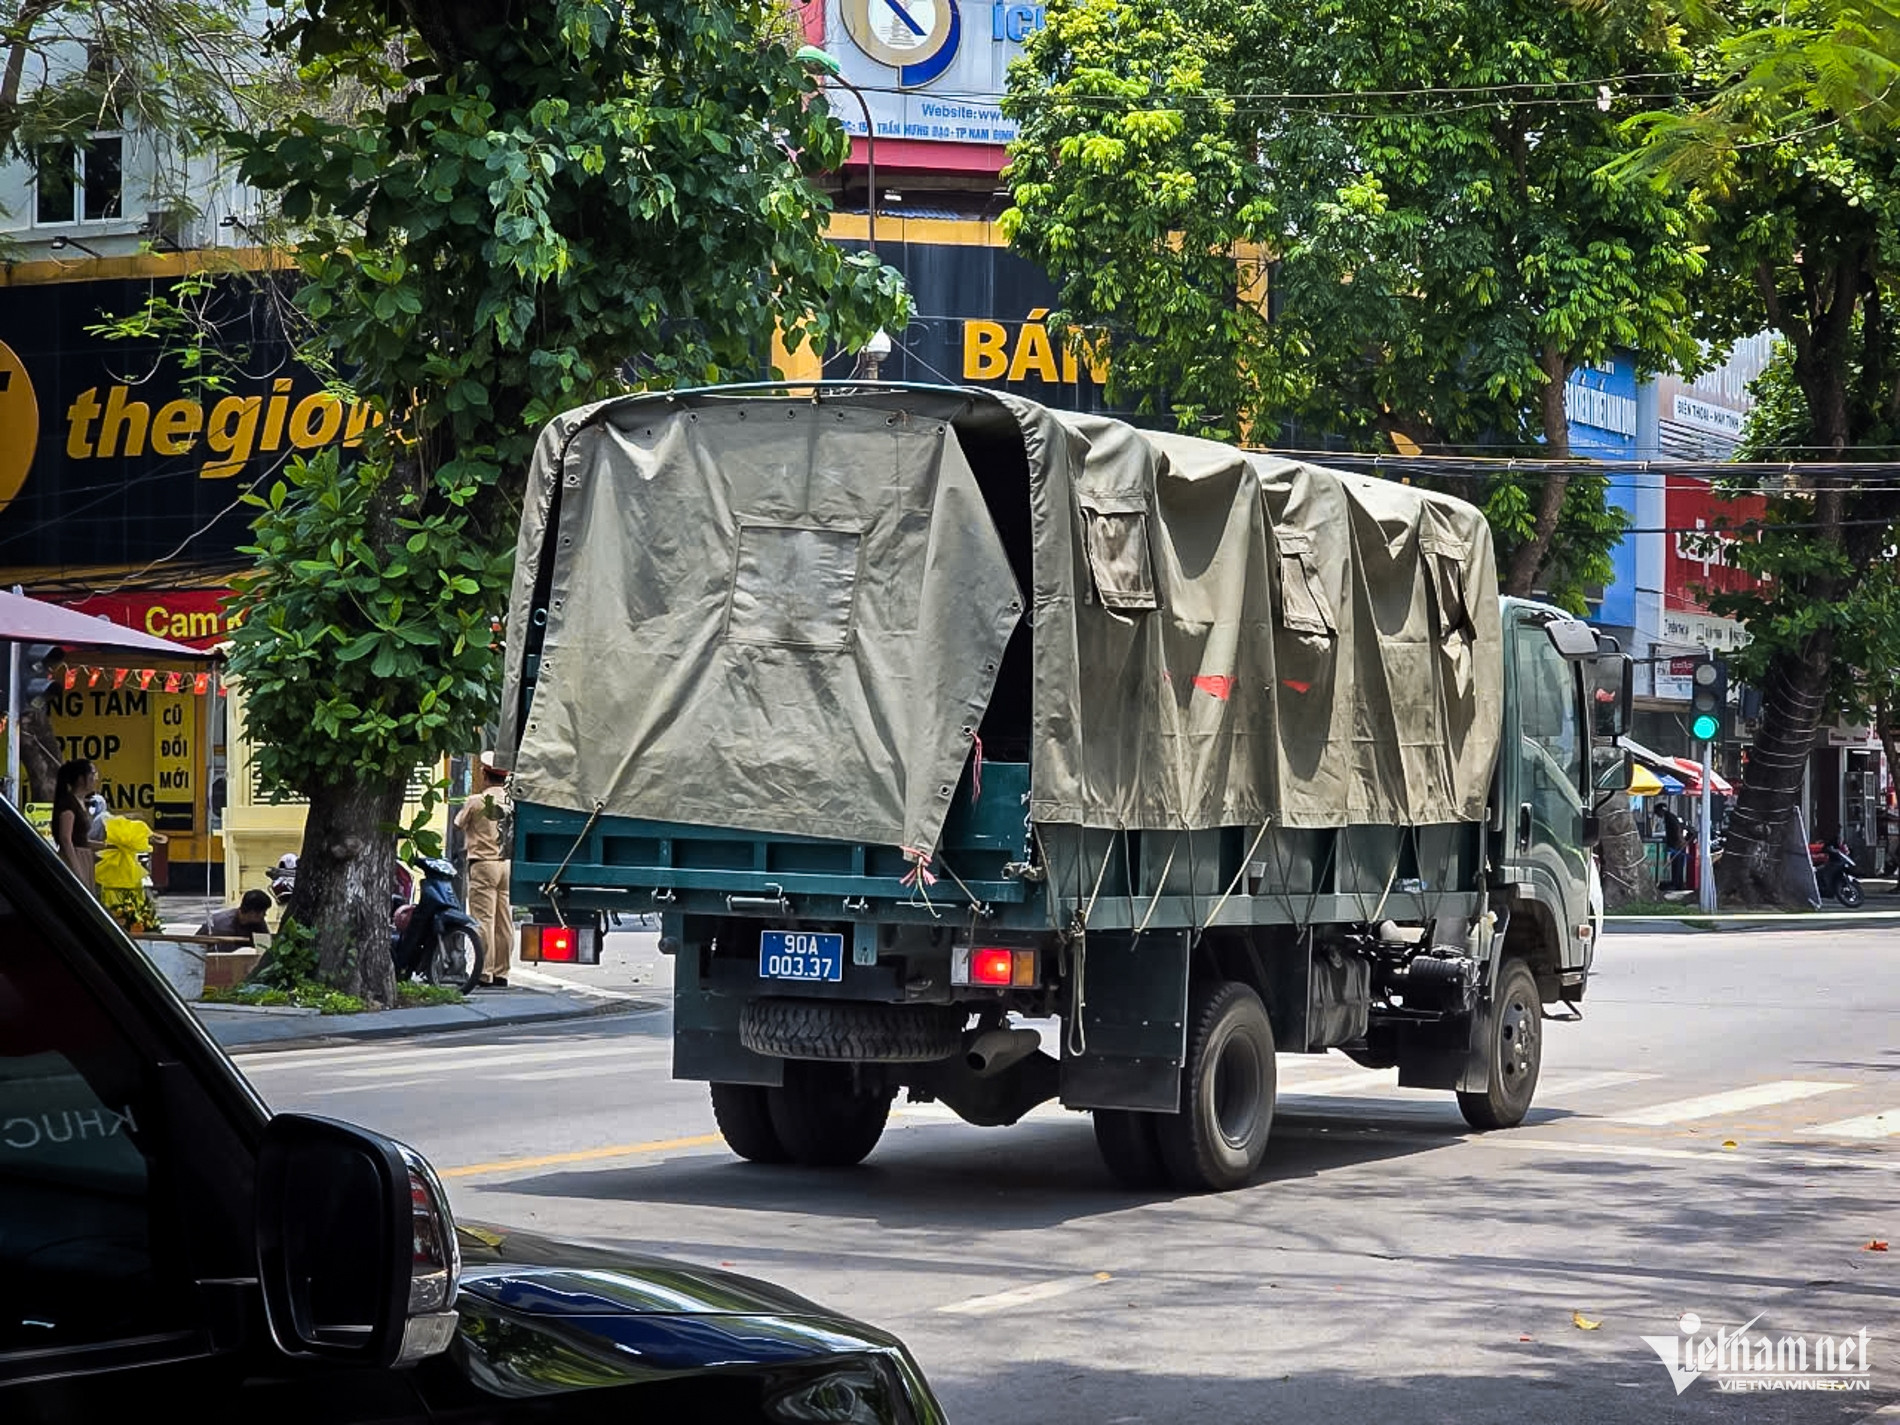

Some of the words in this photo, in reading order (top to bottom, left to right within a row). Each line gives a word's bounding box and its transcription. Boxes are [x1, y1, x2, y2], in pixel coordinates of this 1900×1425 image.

[969, 129, 989, 140] NAM
[145, 606, 219, 638] Cam
[162, 703, 182, 725] CŨ
[159, 767, 189, 789] MỚI
[784, 934, 819, 955] 90A
[768, 955, 832, 978] 003.37
